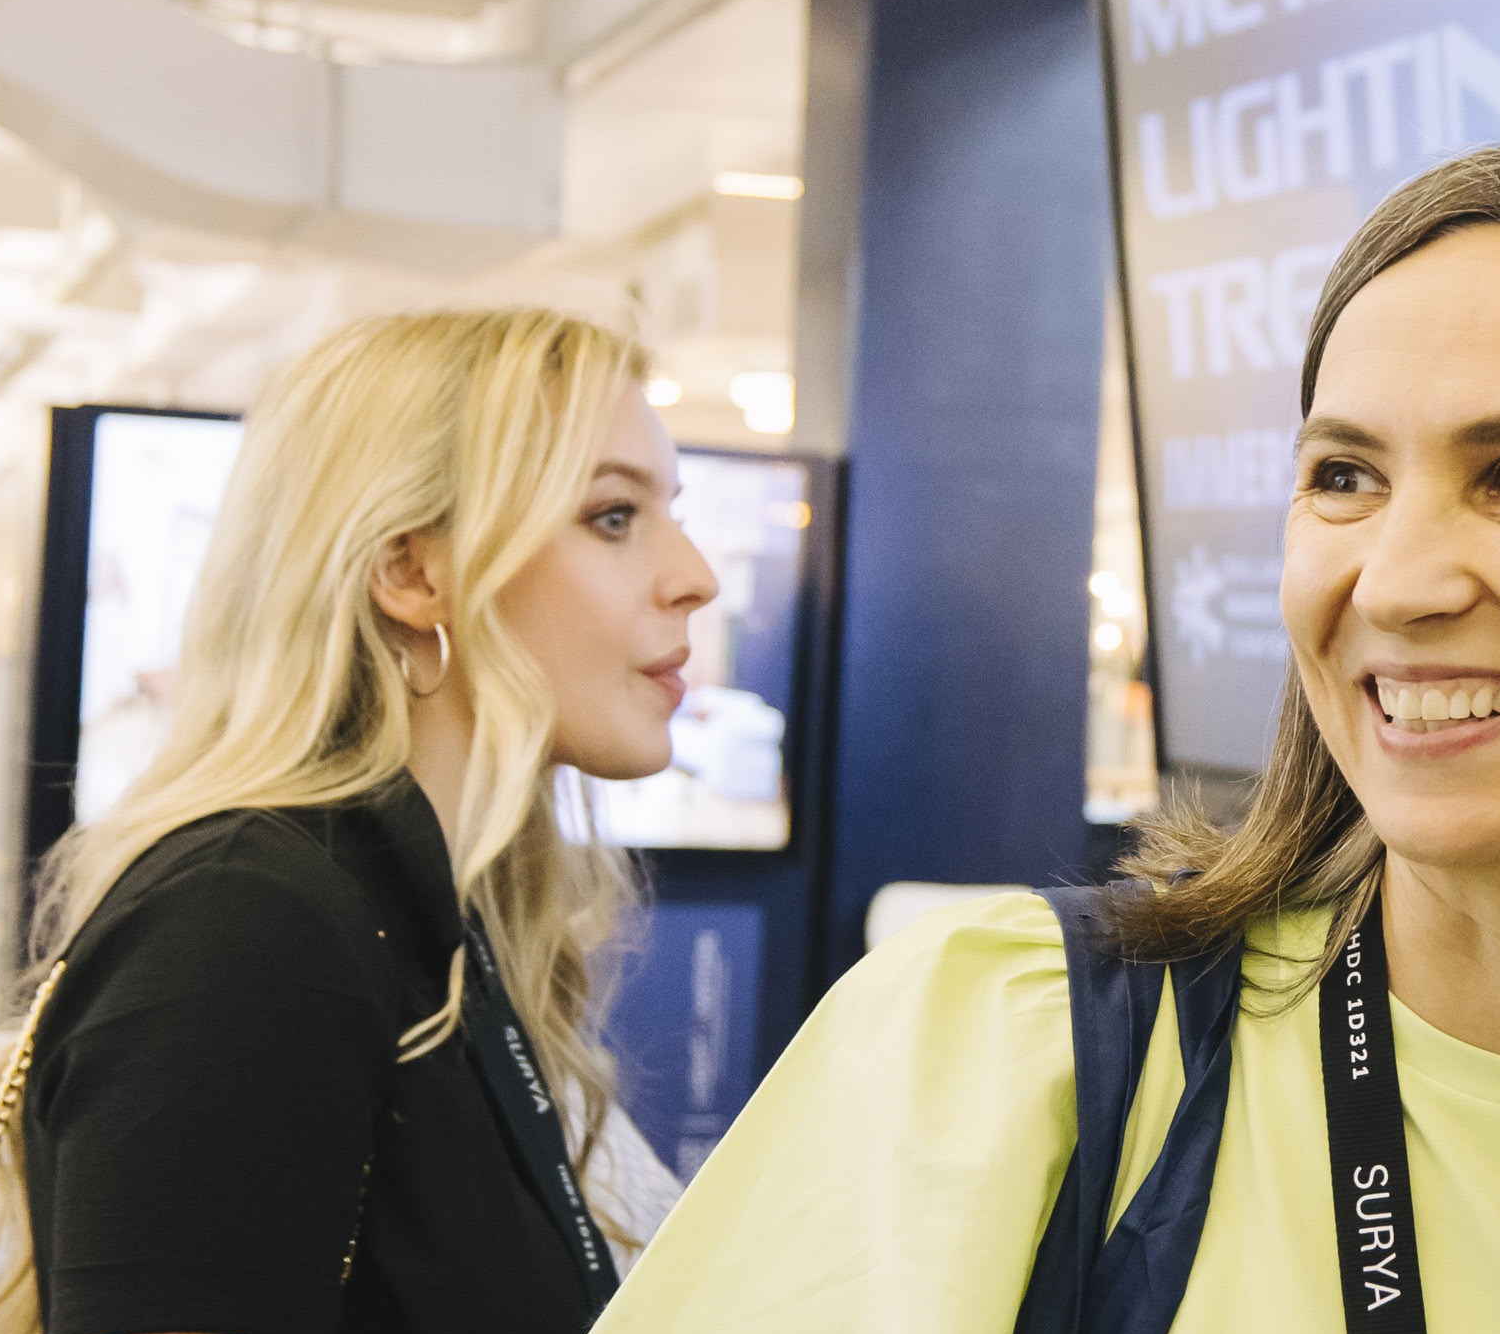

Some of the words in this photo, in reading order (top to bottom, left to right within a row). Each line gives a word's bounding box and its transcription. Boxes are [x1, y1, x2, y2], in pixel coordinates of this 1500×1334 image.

[1346, 925, 1362, 987] HDC
[504, 1024, 550, 1114] SURYA
[1347, 998, 1370, 1081] 1D321
[1353, 1163, 1402, 1312] SURYA
